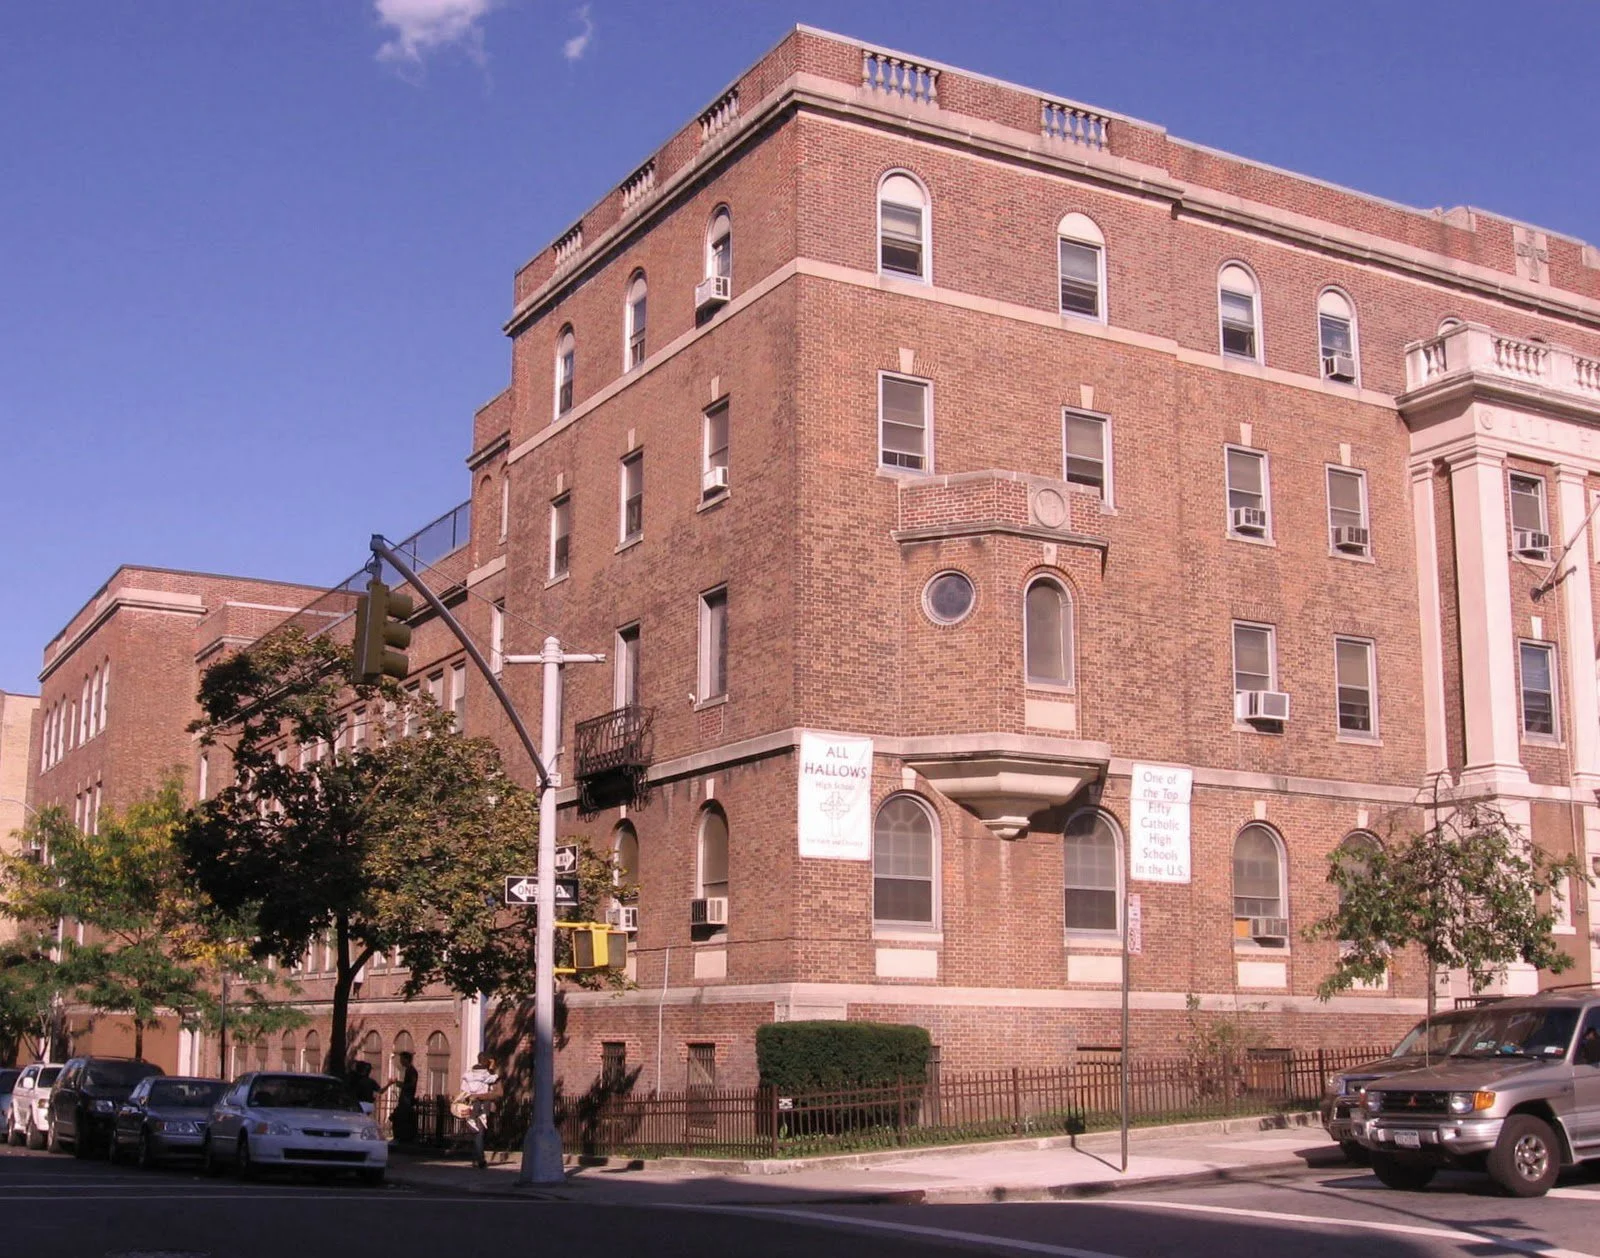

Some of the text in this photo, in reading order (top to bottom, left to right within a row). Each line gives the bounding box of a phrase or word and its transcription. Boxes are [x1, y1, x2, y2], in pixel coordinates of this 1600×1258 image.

[826, 745, 849, 759] ALL
[804, 762, 867, 779] HALLOWS
[1143, 771, 1177, 785] One of
[1143, 787, 1179, 802] the Top
[1148, 802, 1171, 816] Fifty
[1140, 817, 1180, 831] Catholic
[1149, 833, 1171, 847] High
[1143, 847, 1178, 861] Schools
[1148, 864, 1163, 875] the
[1166, 864, 1186, 877] U.S.
[518, 885, 538, 895] ONE
